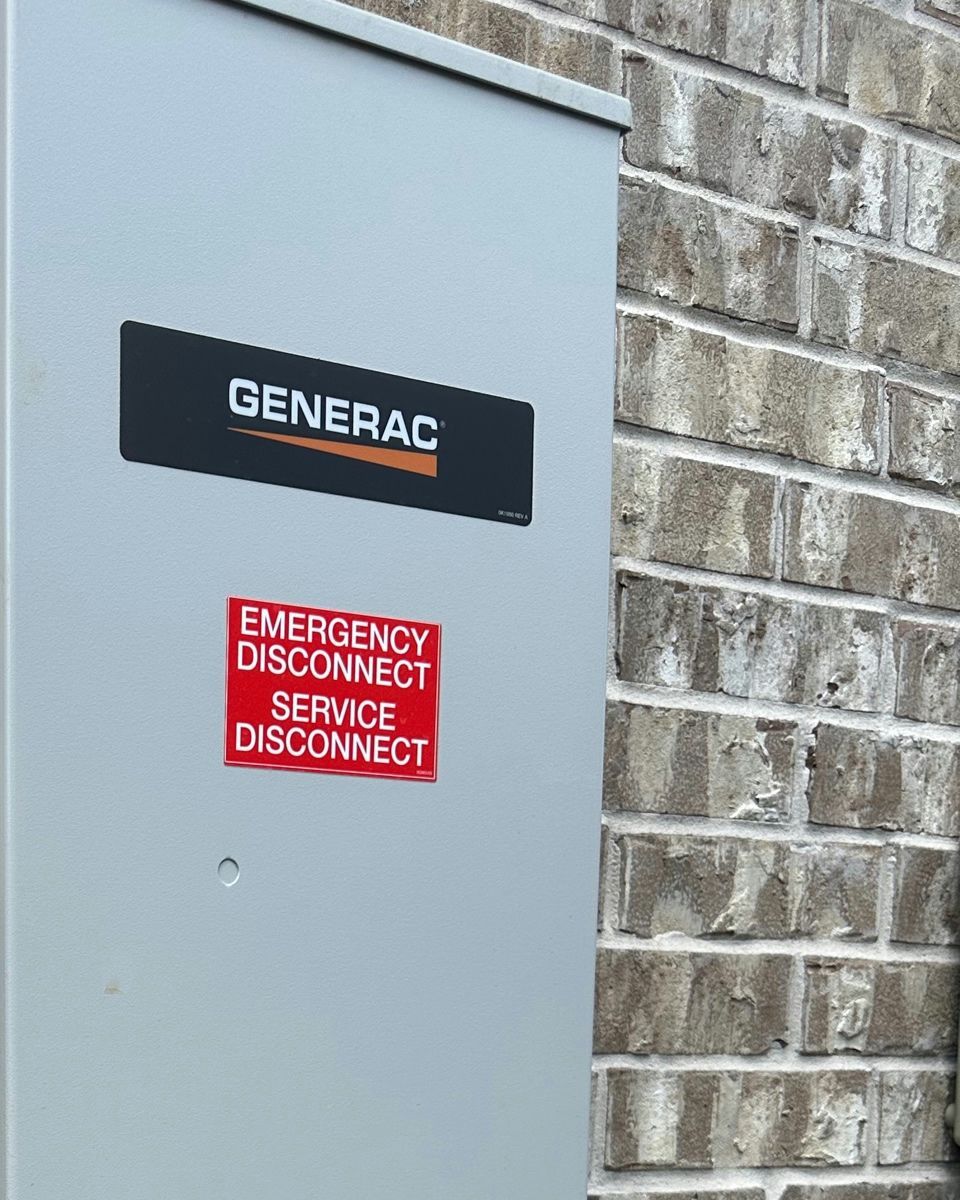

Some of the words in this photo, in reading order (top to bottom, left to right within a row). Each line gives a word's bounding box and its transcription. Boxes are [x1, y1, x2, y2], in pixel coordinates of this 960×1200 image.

[228, 377, 438, 451] GENERAC
[241, 605, 430, 657] EMERGENCY
[238, 640, 431, 690] DISCONNECT
[271, 690, 396, 731] SERVICE
[236, 722, 428, 767] DISCONNECT
